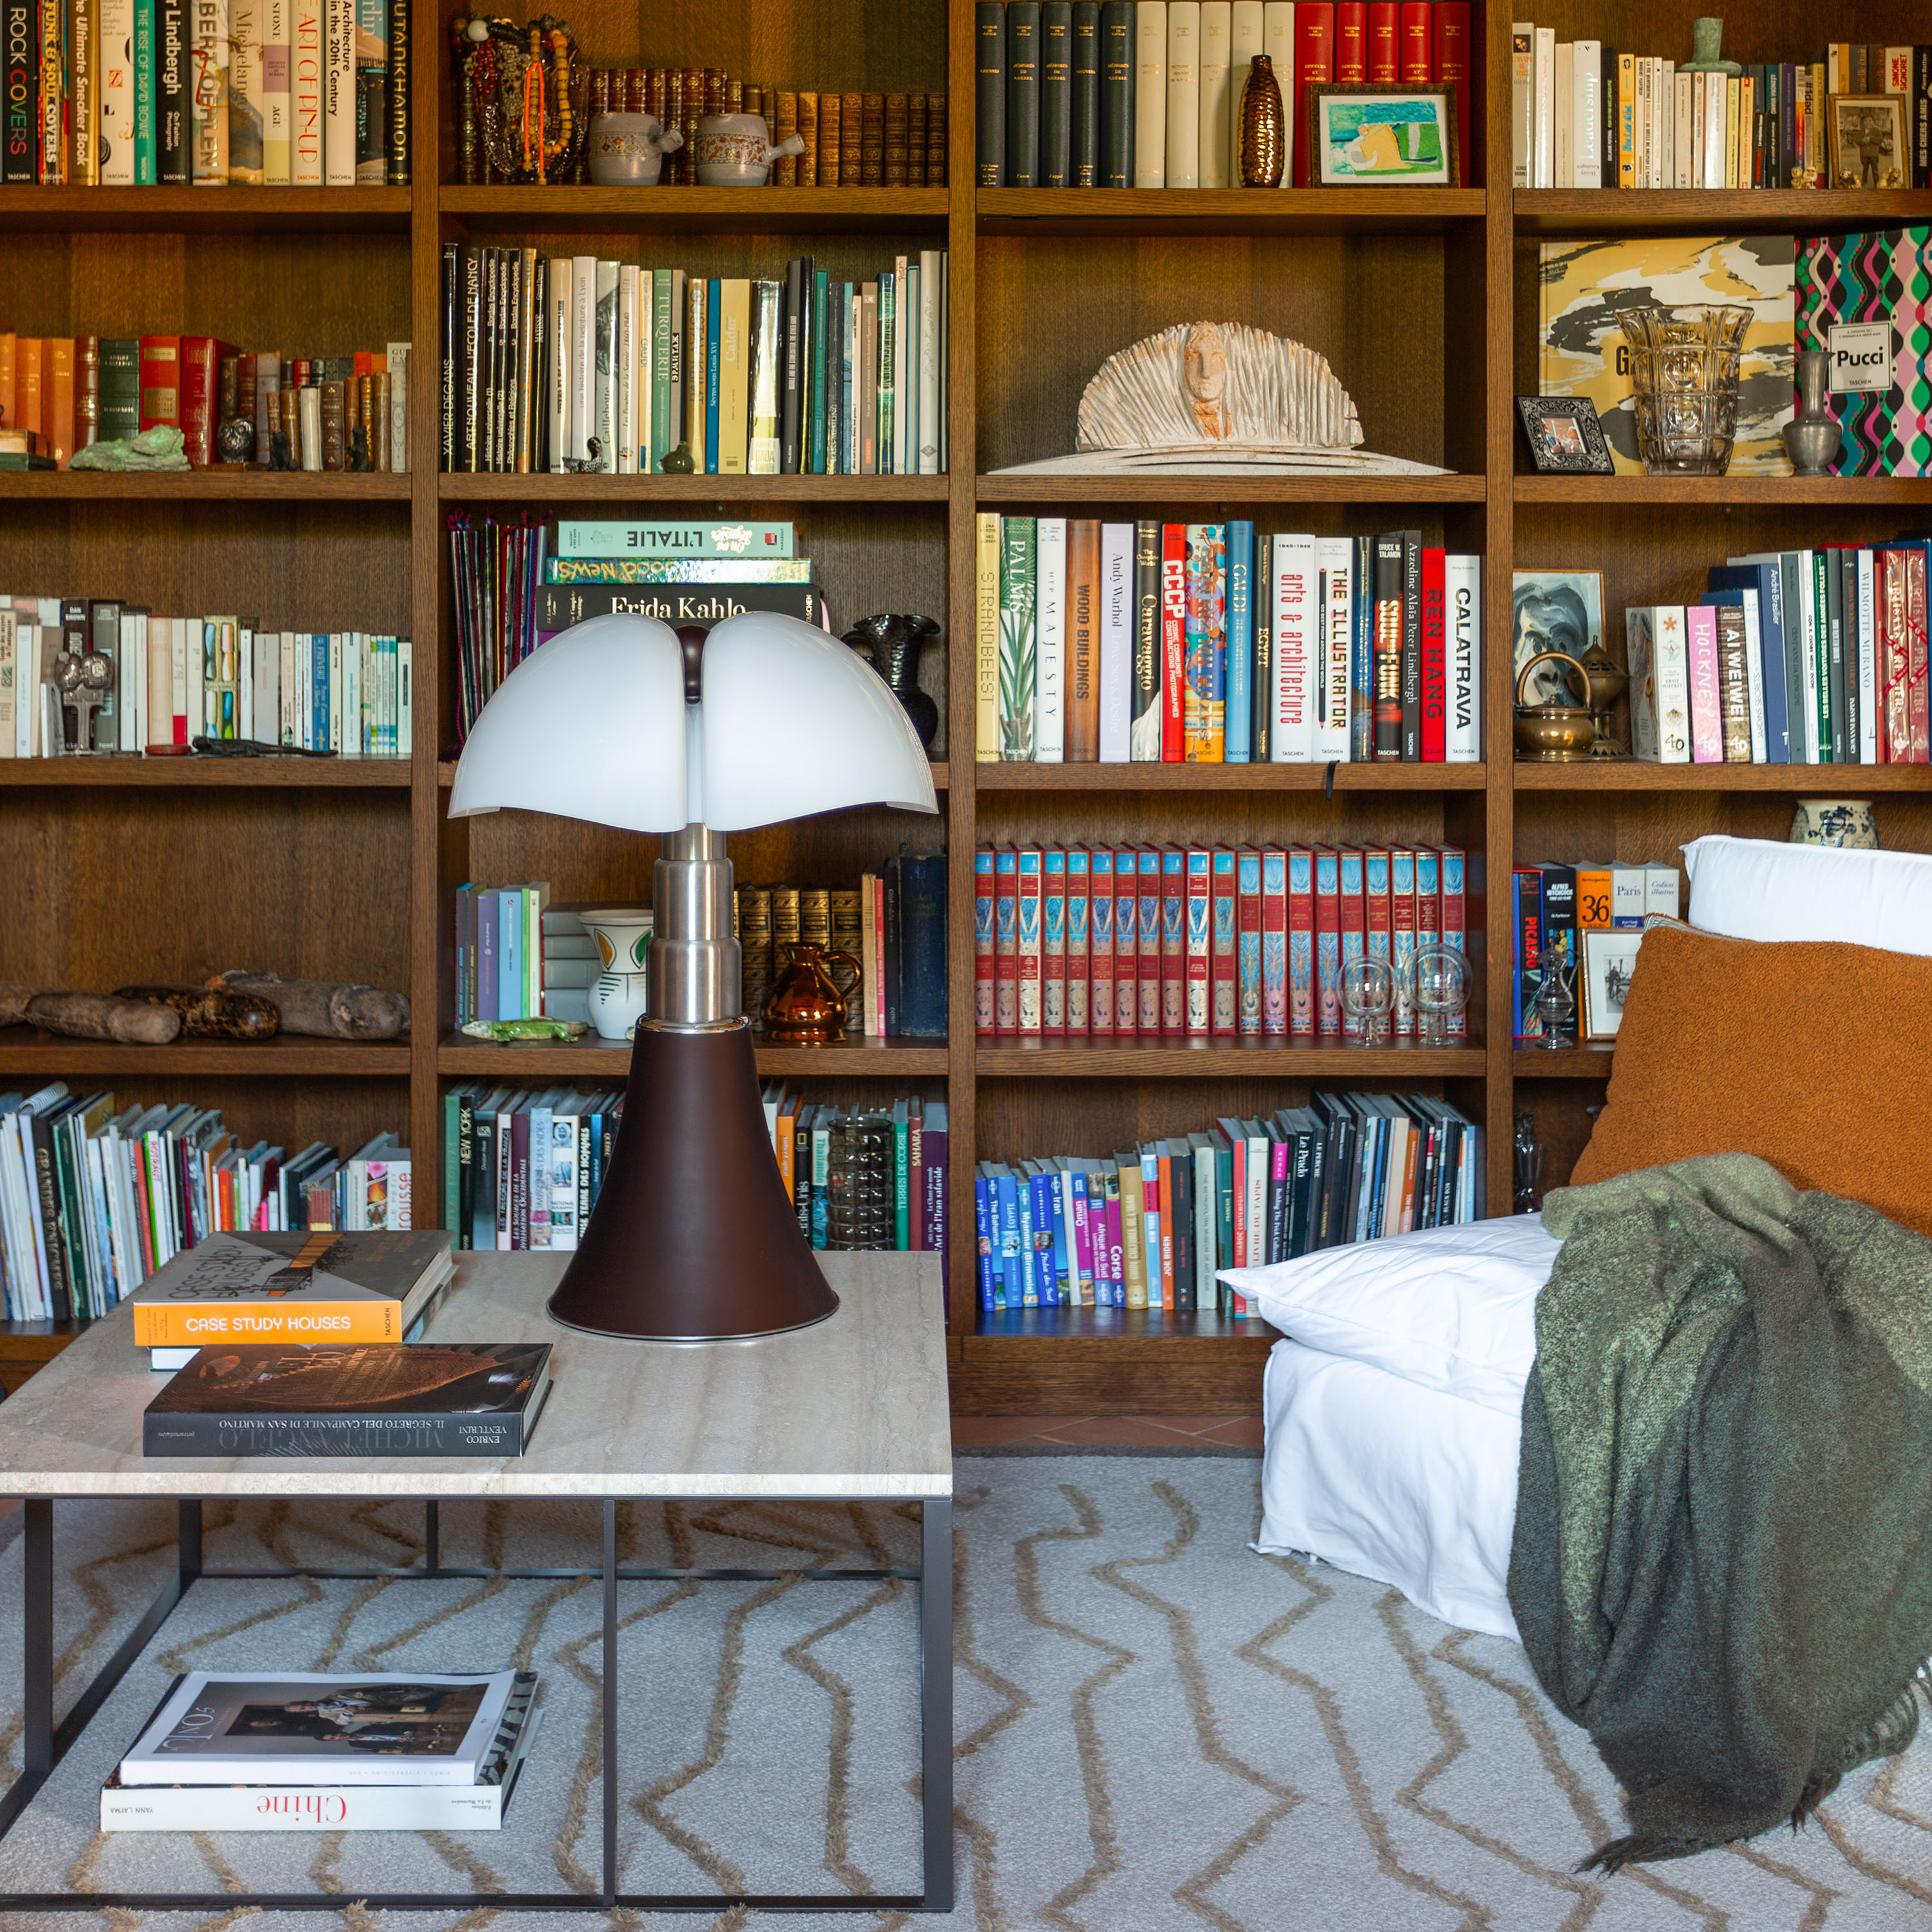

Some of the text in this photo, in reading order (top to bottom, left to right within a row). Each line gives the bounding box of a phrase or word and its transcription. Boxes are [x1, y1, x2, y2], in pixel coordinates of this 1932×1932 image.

[163, 10, 182, 95] Lindbergh
[328, 0, 341, 117] in the 20th Century
[343, 0, 354, 72] Architecture
[10, 8, 27, 155] ROCK COVERS
[75, 17, 89, 166] Ultimate Sneaker Book
[138, 9, 148, 140] THE RISE OF DAVID BOWIE
[235, 10, 253, 127] Michelangelo
[272, 3, 281, 129] STONE AGE
[297, 12, 318, 165] ART OF PIN-UP
[46, 46, 57, 164] & SOUL COVERS
[200, 75, 219, 168] OEHLEN
[1580, 71, 1599, 160] Leadership
[1919, 121, 1927, 147] CHERS
[465, 257, 478, 450] ART DE NANCY
[578, 276, 588, 392] histoire de la peinture Lyon
[654, 293, 671, 381] TURQUERIE
[724, 316, 737, 362] Calder
[1837, 346, 1884, 368] Pucci
[442, 401, 453, 456] XAVIER
[601, 386, 611, 444] Caillebotte
[627, 530, 703, 547] L'ITALIE
[1408, 542, 1418, 589] Azzedine
[1009, 540, 1026, 613] PALMS
[1162, 560, 1186, 619] CCCP
[611, 596, 747, 620] Frida Kahlo
[1862, 572, 1871, 688] WILMOTTE MURANO
[980, 572, 995, 705] STRANDBEEST
[1042, 600, 1057, 717] MAJESTY
[1076, 584, 1090, 701] WOOD BUILDINGS
[1110, 552, 1124, 734] Andy Warhol Desire
[1136, 594, 1158, 691] Caravaggio
[1172, 649, 1181, 679] COMMUNIST
[1258, 627, 1269, 668] EGYPT
[1280, 573, 1308, 724] arts architecture
[1330, 567, 1348, 730] THE ILLUSTRATOR
[1378, 599, 1400, 701] SOUL FUNK
[1425, 589, 1443, 719] REN HANG
[1455, 587, 1472, 730] CALATRAVA
[1165, 620, 1179, 718] CONSTRUCTIONS PHOTOGRAPHED
[1405, 649, 1417, 704] Lindbergh
[1694, 623, 1716, 719] HOCKNEY
[1726, 629, 1745, 722] AI WEIWEI
[1665, 734, 1685, 751] 40
[1729, 735, 1748, 752] 40
[1582, 895, 1609, 923] 36
[1617, 885, 1642, 897] Paris
[1651, 880, 1674, 889] Codices
[1525, 916, 1538, 969] PICASSO
[460, 1107, 471, 1164] NEW YORK
[536, 1121, 545, 1146] INDES
[911, 1128, 921, 1168] SAHARA
[1296, 1135, 1310, 1179] Le Prado
[518, 1159, 527, 1206] OCCIDENTALE
[579, 1128, 591, 1215] TERRE DES HOMMES
[897, 1132, 906, 1211] TERRES DE CORSE
[933, 1166, 943, 1198] safavide
[1314, 1151, 1322, 1179] PERCHE
[399, 1172, 412, 1229] rousse
[1052, 1196, 1062, 1215] Iran
[1075, 1200, 1084, 1227] Oman
[1253, 1214, 1260, 1229] DU
[1021, 1211, 1036, 1294] Myanmar (Birmanie)
[1097, 1222, 1108, 1278] Afrique du Sud
[1110, 1245, 1122, 1280] Corse
[1127, 1231, 1138, 1260] CULTUREL
[186, 1316, 351, 1332] CASE STUDY HOUSES
[218, 1428, 446, 1449] MICHELANGELO
[219, 1419, 445, 1429] IL SEGRETO DEL CAMPANILE DI SAN MARTINO
[459, 1425, 507, 1434] VENTURINI
[466, 1434, 500, 1444] ENRICO
[256, 1794, 347, 1824] Chine
